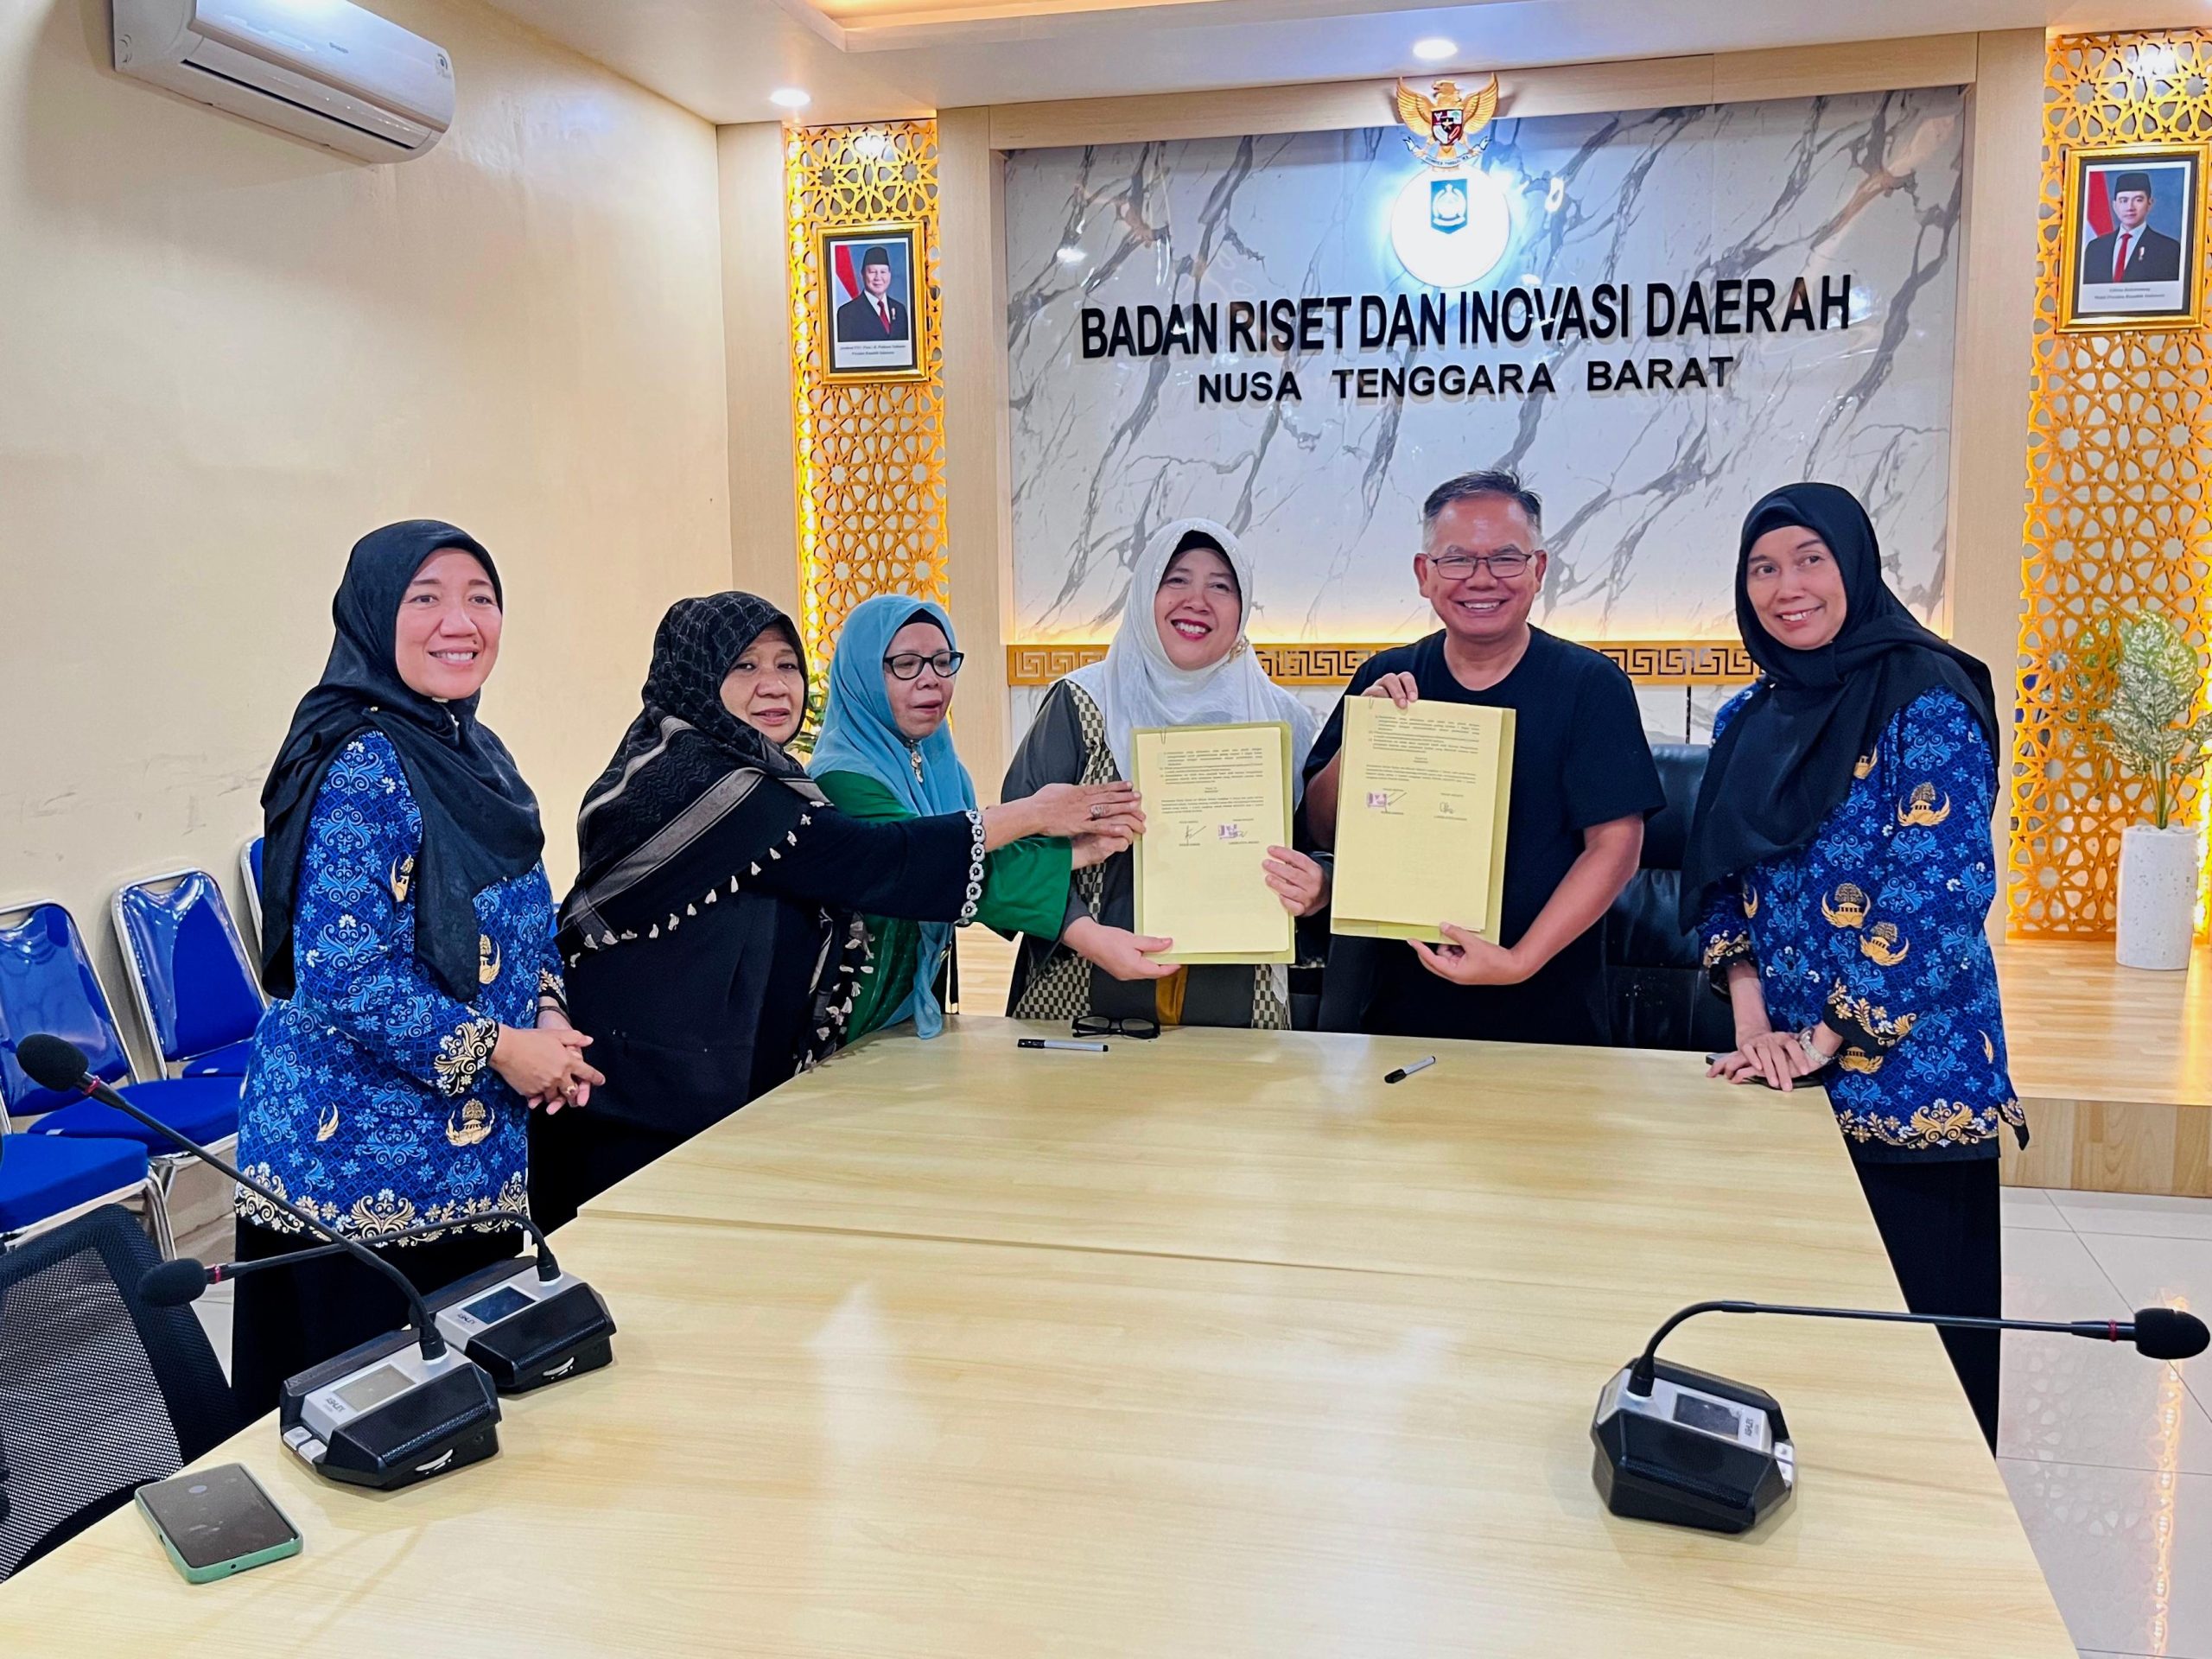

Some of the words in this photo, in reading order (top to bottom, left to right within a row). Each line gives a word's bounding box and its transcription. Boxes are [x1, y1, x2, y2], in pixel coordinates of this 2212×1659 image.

[1081, 302, 1217, 359] BADAN
[1230, 296, 1352, 353] RISET
[1360, 292, 1446, 348] DAN
[1459, 283, 1629, 345] INOVASI
[1646, 274, 1851, 337] DAERAH
[1198, 371, 1302, 404] NUSA
[1332, 362, 1556, 398] TENGGARA
[1586, 356, 1733, 391] BARAT
